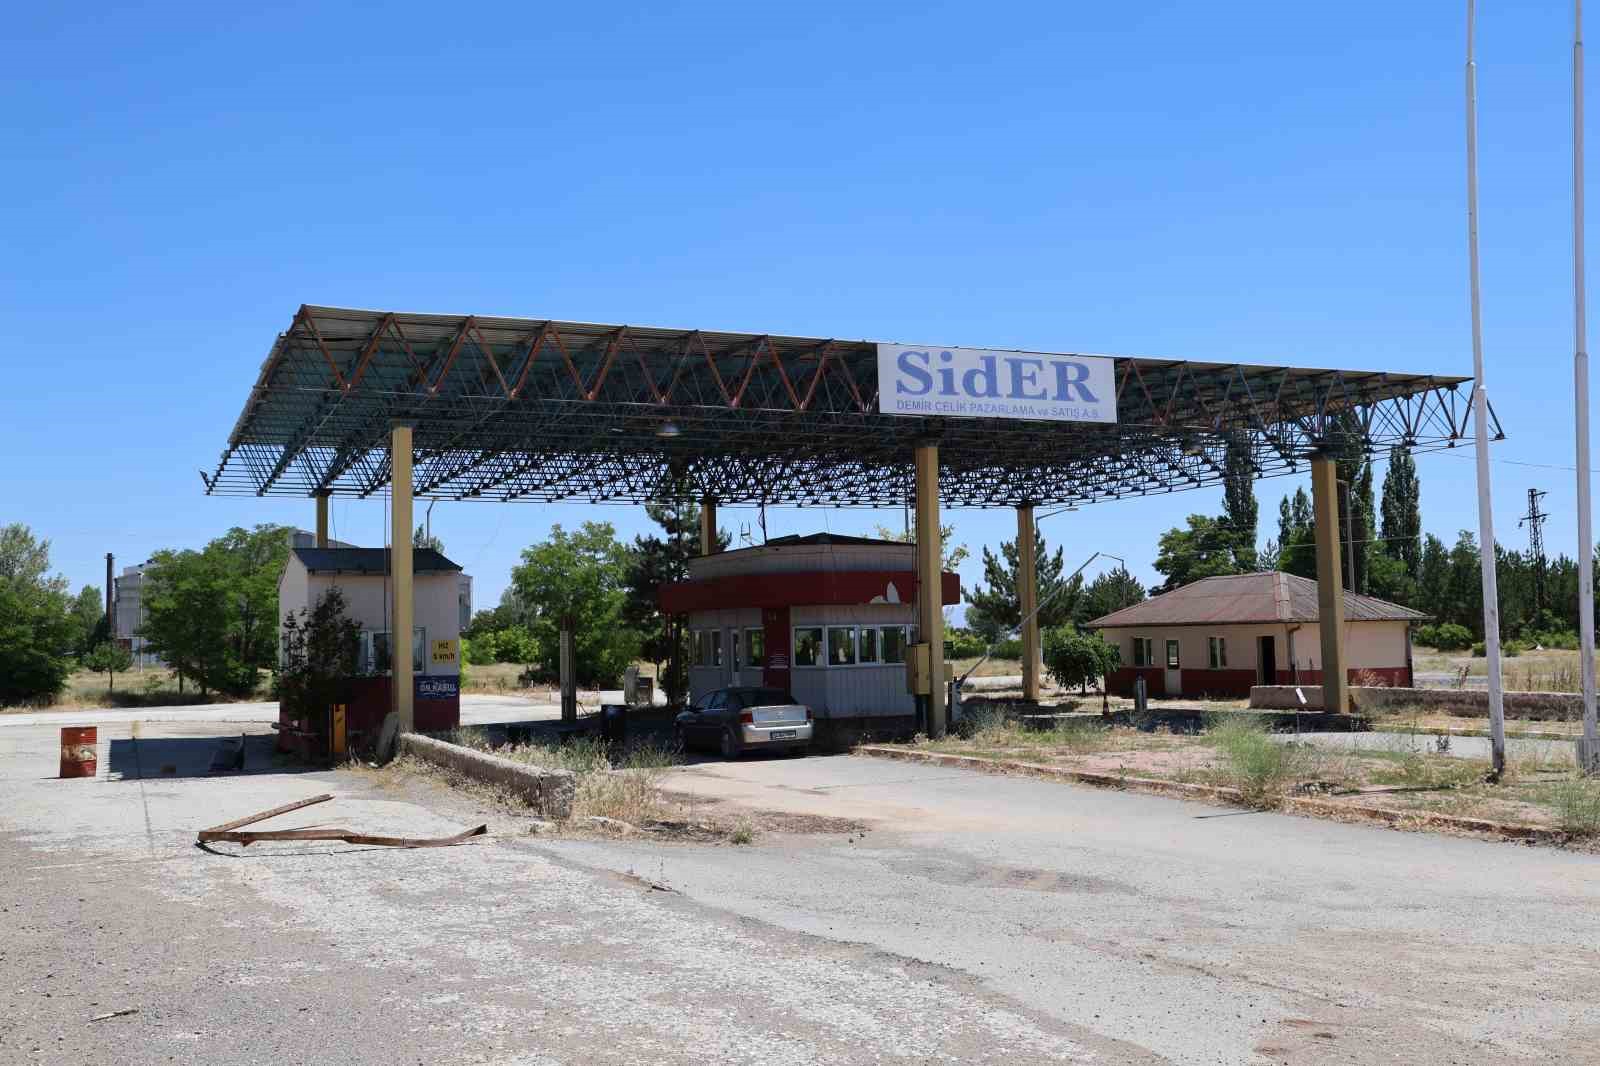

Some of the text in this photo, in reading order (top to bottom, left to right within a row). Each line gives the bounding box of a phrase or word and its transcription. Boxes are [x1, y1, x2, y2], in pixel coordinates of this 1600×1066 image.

[896, 350, 1099, 402] SidER
[896, 399, 931, 411] DEMİR
[934, 401, 966, 413] ÇELİK
[969, 403, 1035, 416] PAZARLAMA
[1051, 407, 1080, 419] SATIŞ
